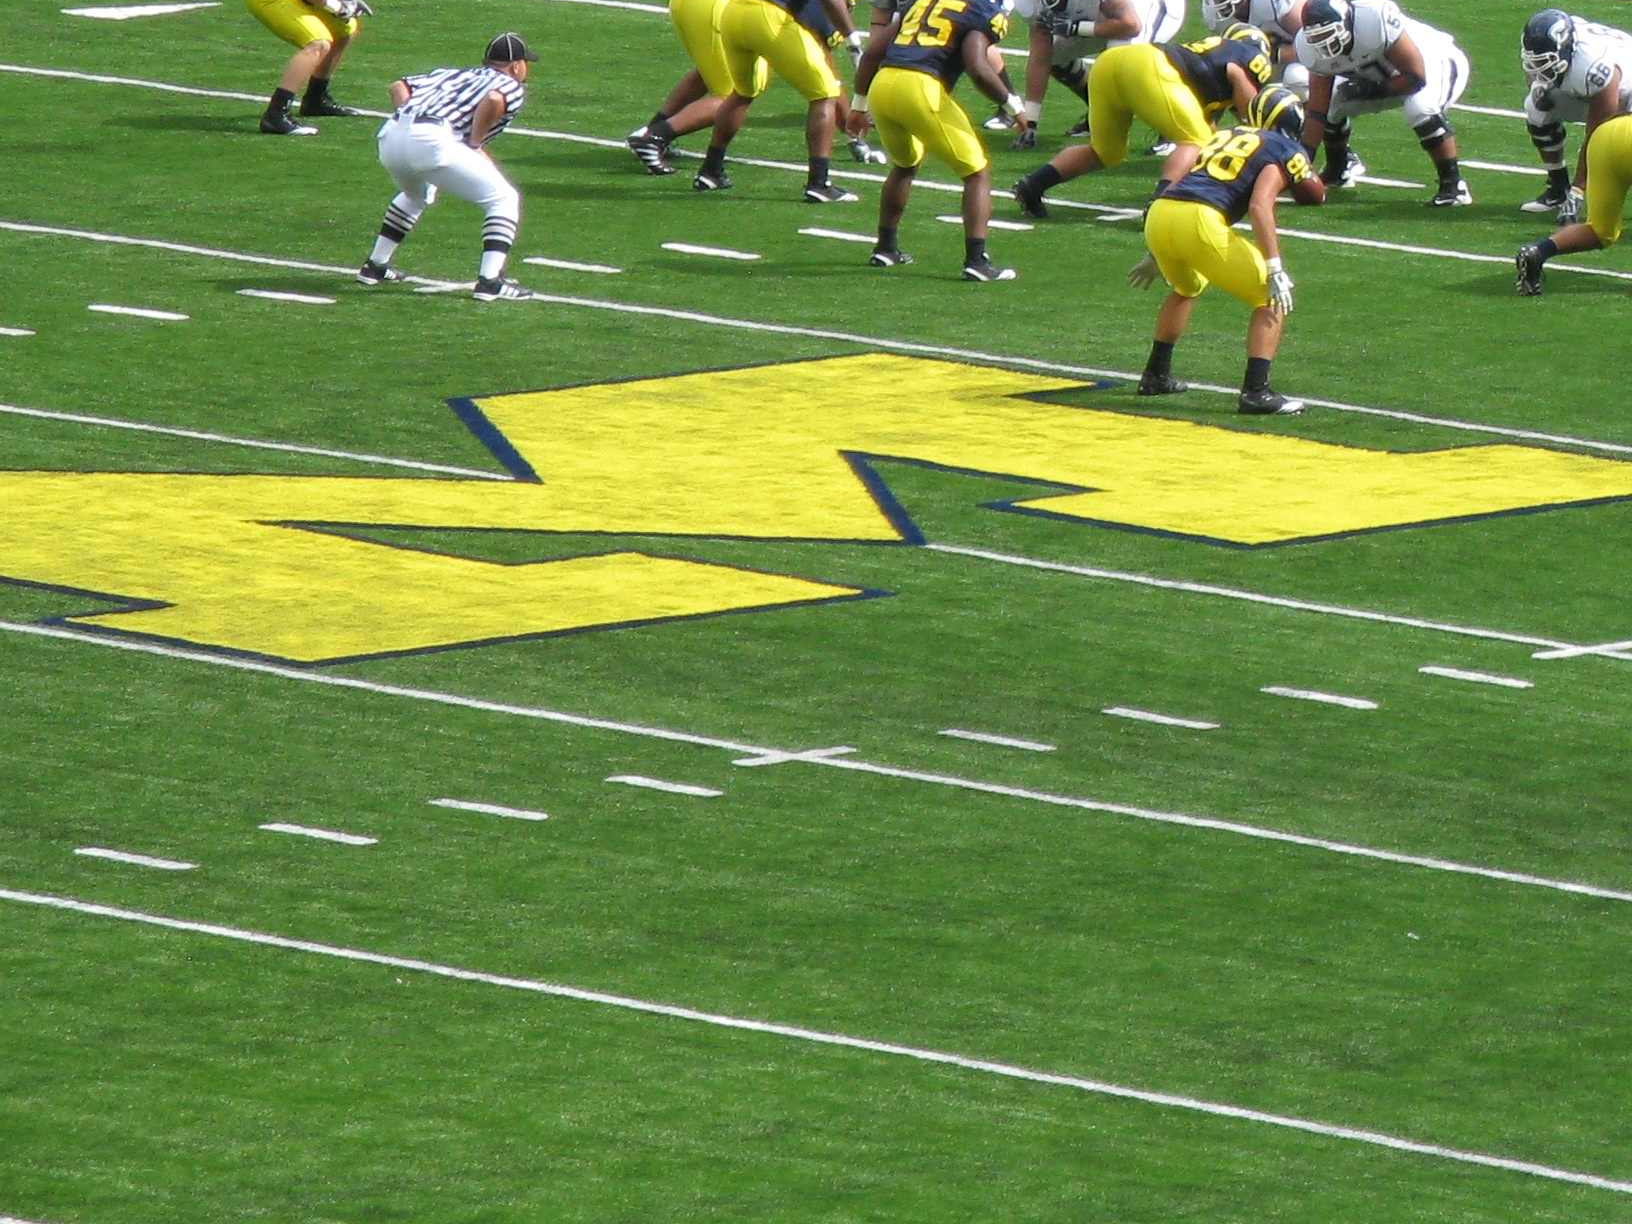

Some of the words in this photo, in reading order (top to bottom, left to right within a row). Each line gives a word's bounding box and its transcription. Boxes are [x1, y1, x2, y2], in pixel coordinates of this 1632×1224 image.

[989, 12, 1011, 40] 45
[1586, 61, 1611, 89] 66
[1189, 129, 1263, 184] 88
